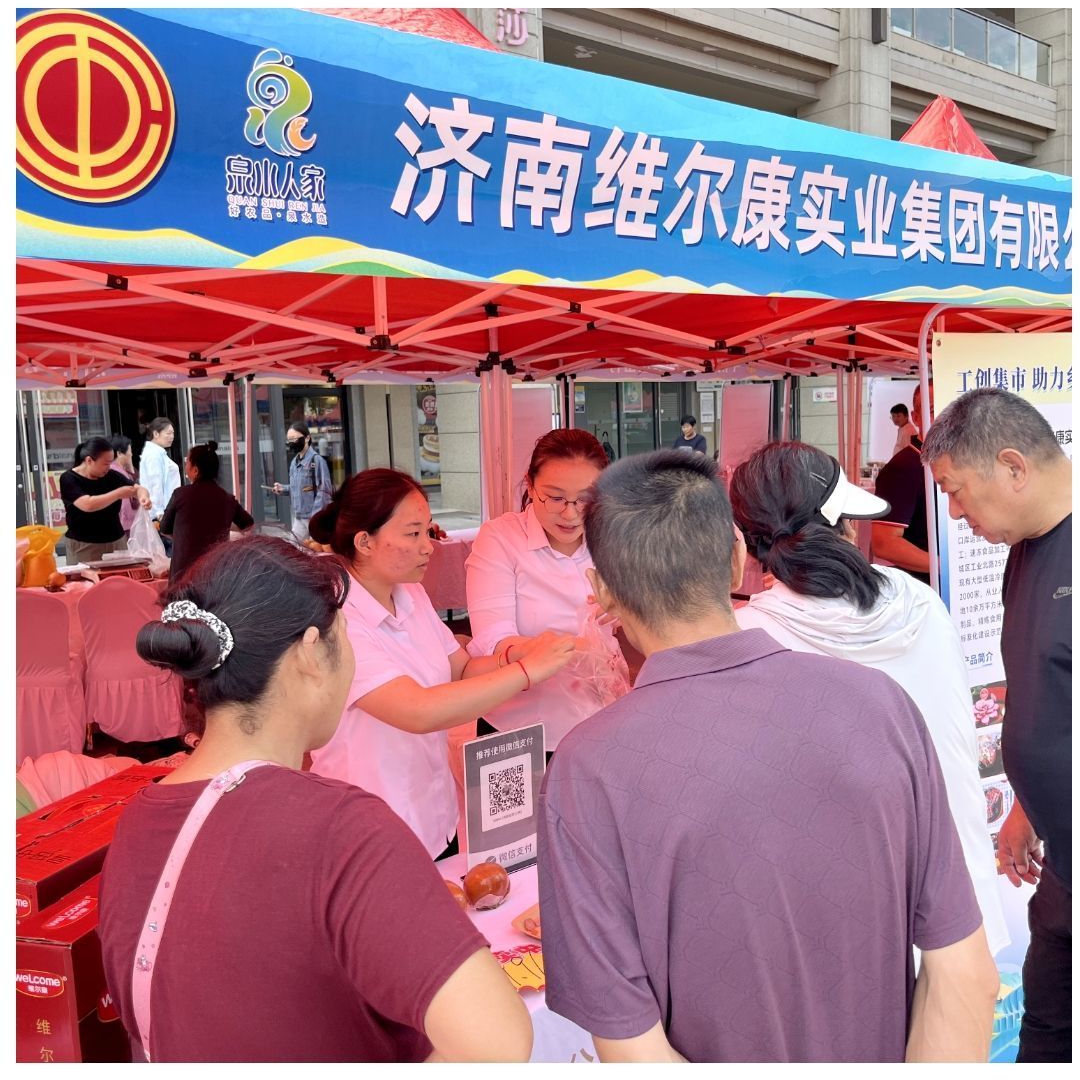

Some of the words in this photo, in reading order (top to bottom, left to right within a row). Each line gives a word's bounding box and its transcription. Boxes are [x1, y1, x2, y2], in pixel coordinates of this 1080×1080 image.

[225, 155, 325, 201] 泉水人家
[390, 91, 1072, 271] 济南维尔康实业集团有限
[227, 194, 258, 207] QUAN
[261, 198, 285, 210] SHUI
[287, 200, 308, 212] REN
[312, 203, 326, 214] JIA
[956, 367, 1025, 392] 工创集市
[475, 736, 534, 761] 推荐使用微信支付
[499, 843, 532, 862] 微信支付
[36, 1019, 54, 1062] 维尔
